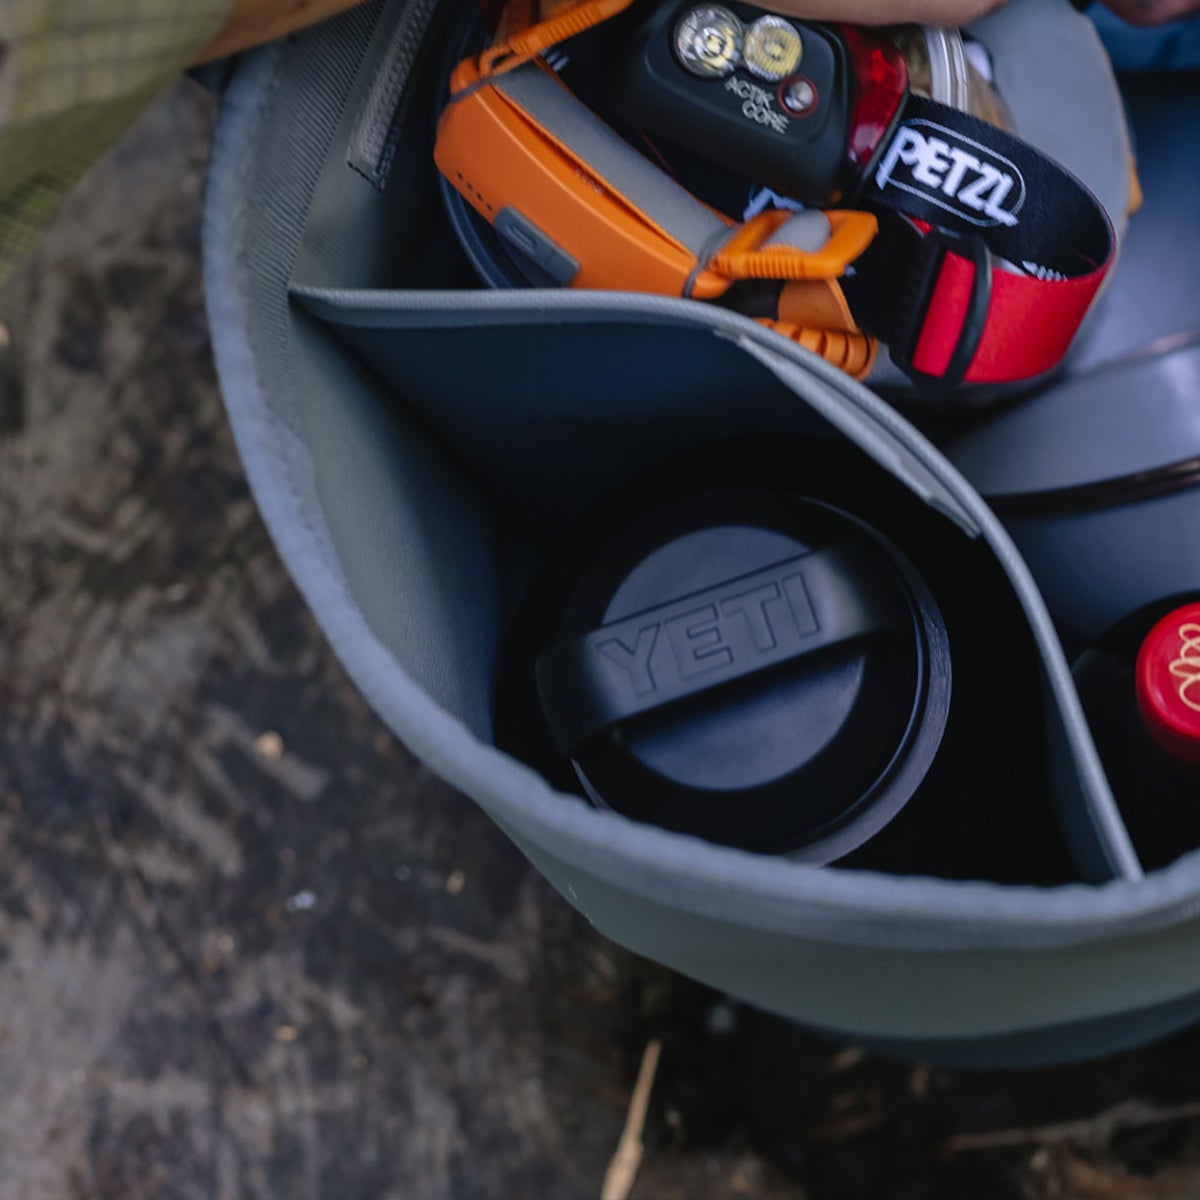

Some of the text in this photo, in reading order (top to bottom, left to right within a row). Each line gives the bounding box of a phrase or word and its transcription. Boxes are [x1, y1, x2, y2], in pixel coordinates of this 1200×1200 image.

[742, 100, 789, 135] CORE
[875, 126, 1019, 227] PETZL
[595, 571, 821, 697] YETI
